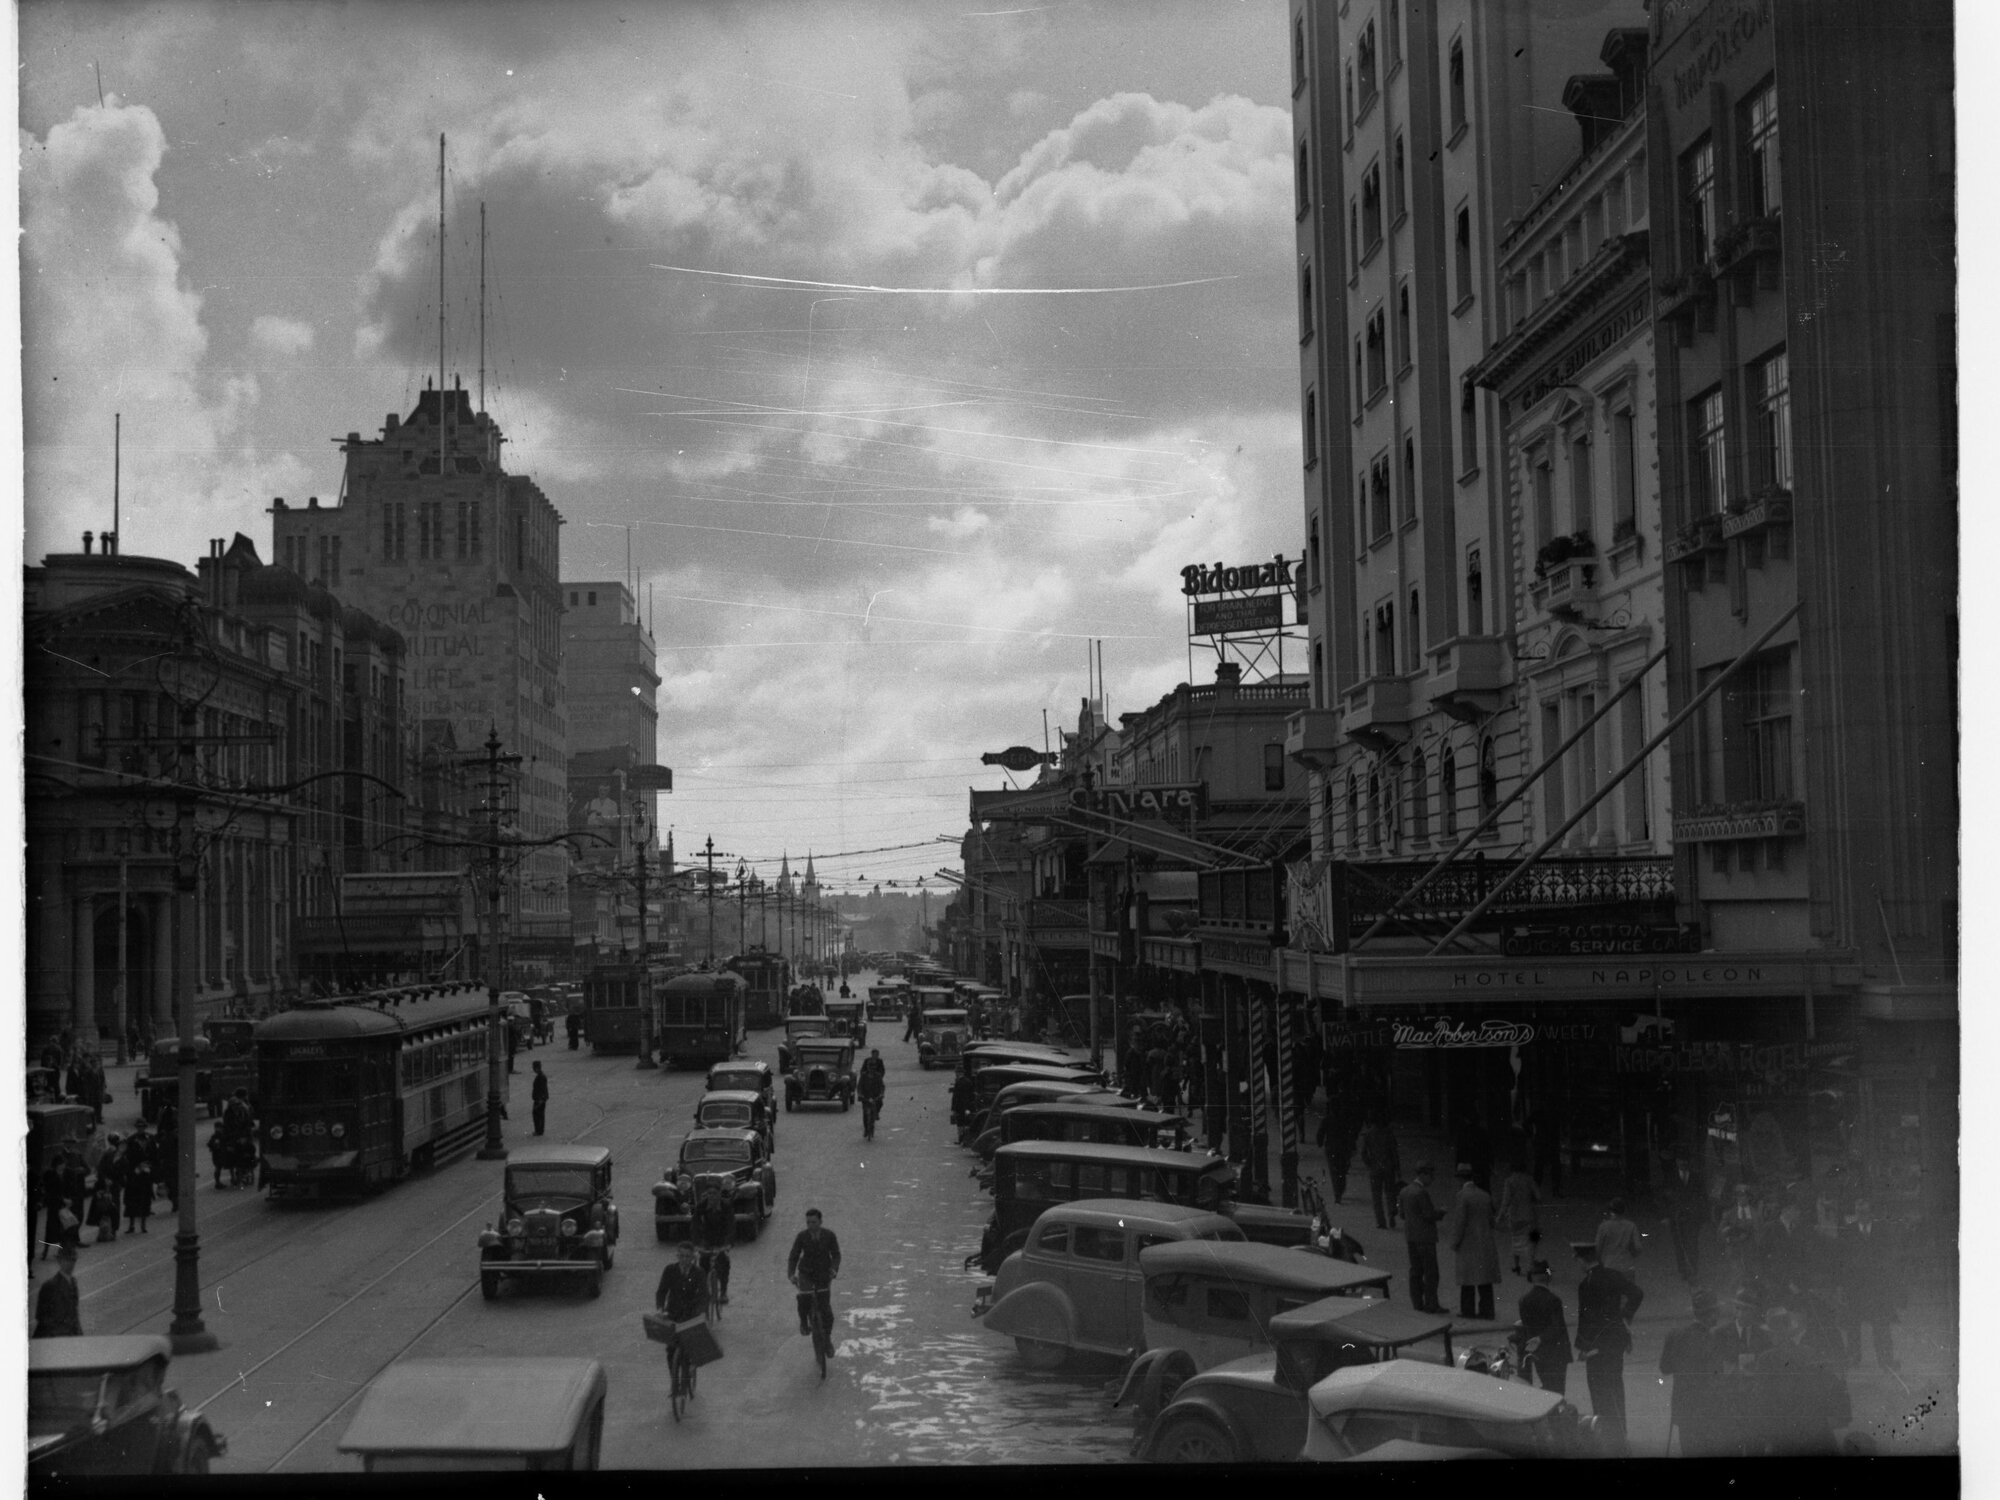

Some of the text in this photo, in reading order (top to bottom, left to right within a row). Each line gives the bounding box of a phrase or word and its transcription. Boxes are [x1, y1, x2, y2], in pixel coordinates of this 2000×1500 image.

[1180, 553, 1293, 595] Bidomak
[388, 601, 491, 625] COLONIAL
[1569, 940, 1644, 952] SERVICE
[1454, 968, 1762, 986] HOTEL NAPOLEON
[288, 1120, 327, 1136] 365
